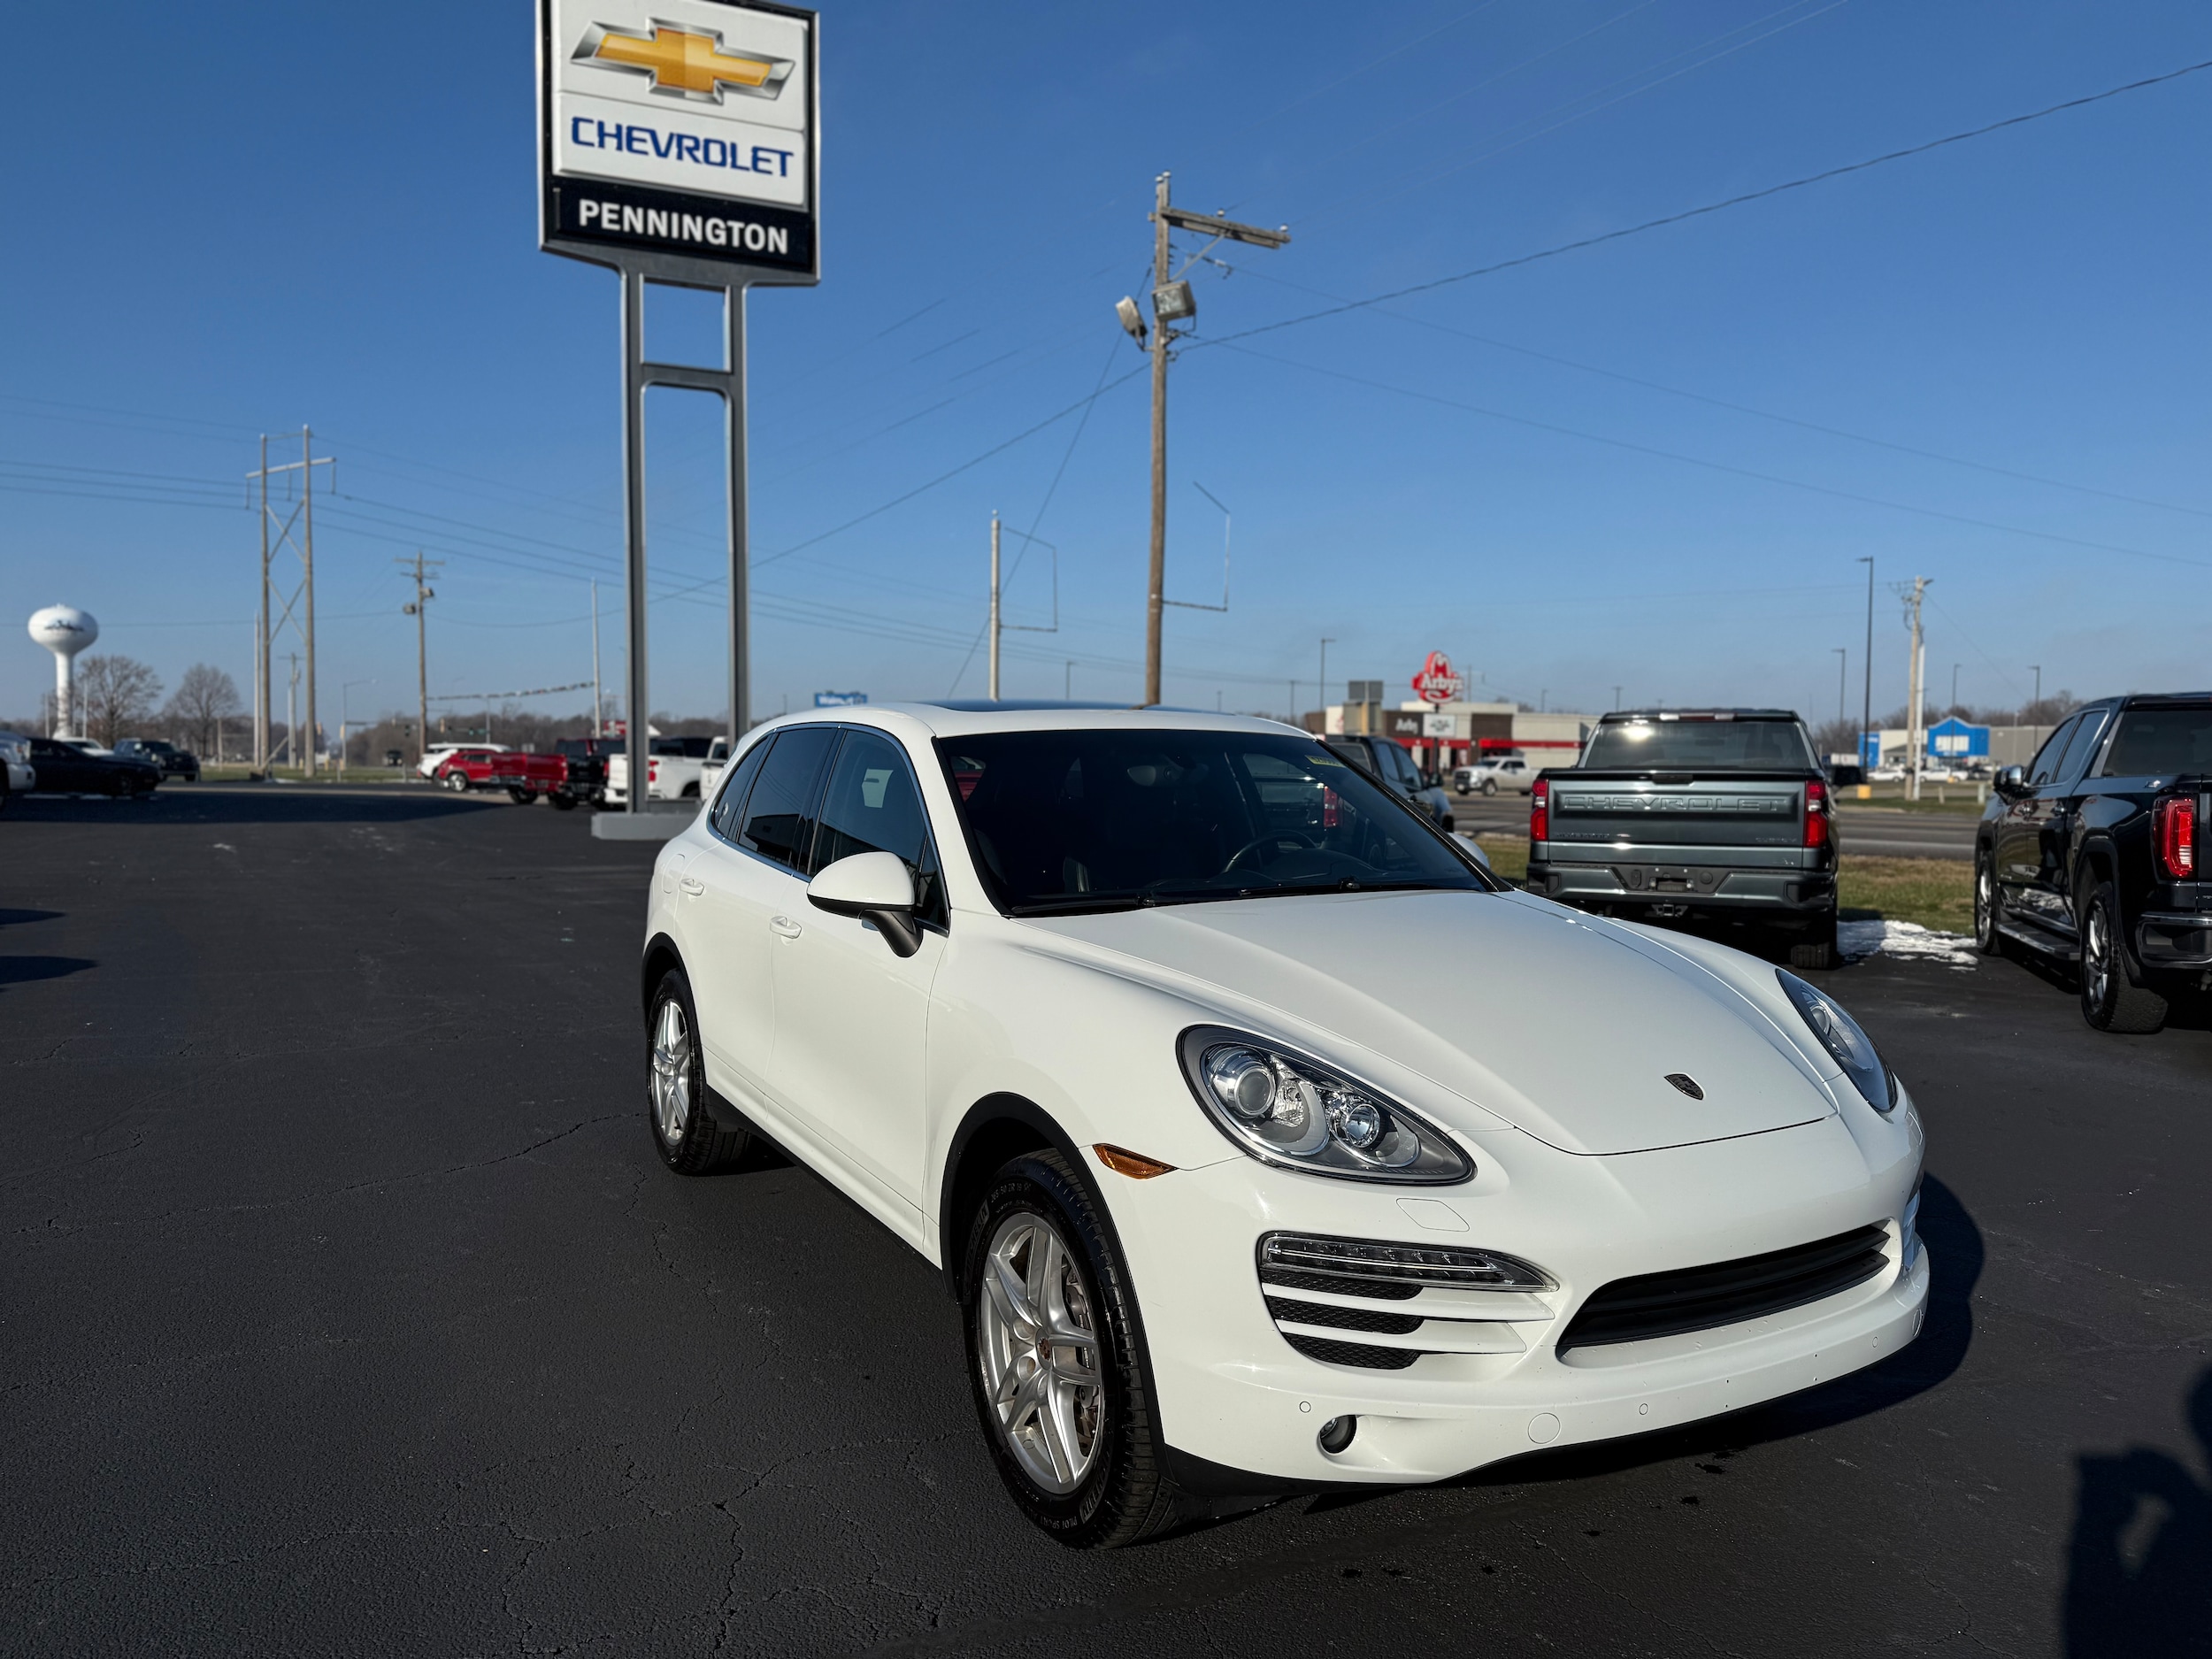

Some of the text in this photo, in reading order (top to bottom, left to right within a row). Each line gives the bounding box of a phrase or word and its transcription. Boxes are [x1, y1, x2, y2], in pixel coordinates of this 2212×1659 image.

[572, 116, 795, 178] CHEVROLET
[579, 199, 788, 255] PENNINGTON
[1419, 672, 1463, 695] Arby's
[1394, 718, 1418, 734] Arby
[1563, 795, 1787, 812] CHEVROLET
[1062, 1516, 1078, 1530] PILOT
